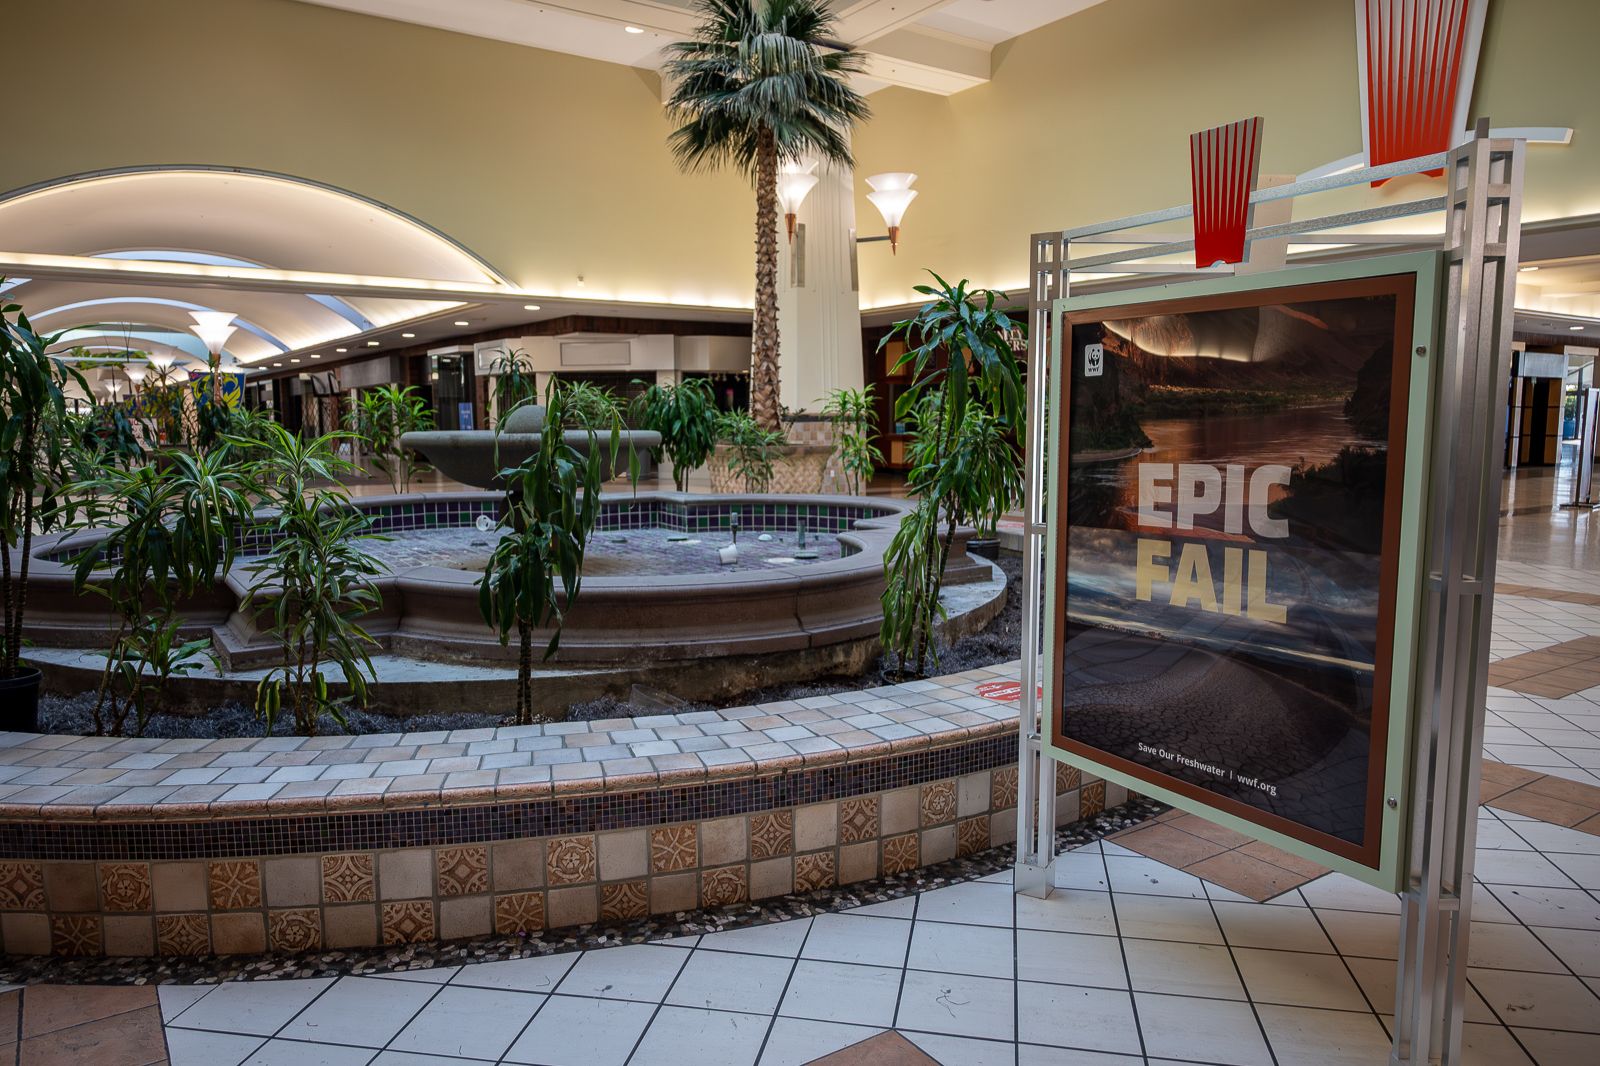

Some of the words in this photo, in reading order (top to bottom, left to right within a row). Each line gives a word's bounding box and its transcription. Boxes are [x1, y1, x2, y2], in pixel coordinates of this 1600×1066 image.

[1137, 463, 1292, 539] EPIC
[1135, 538, 1288, 624] FAIL
[1138, 742, 1157, 755] Save
[1158, 749, 1175, 761] Our
[1176, 753, 1226, 777] Freshwater
[1237, 774, 1277, 796] wwf.org
